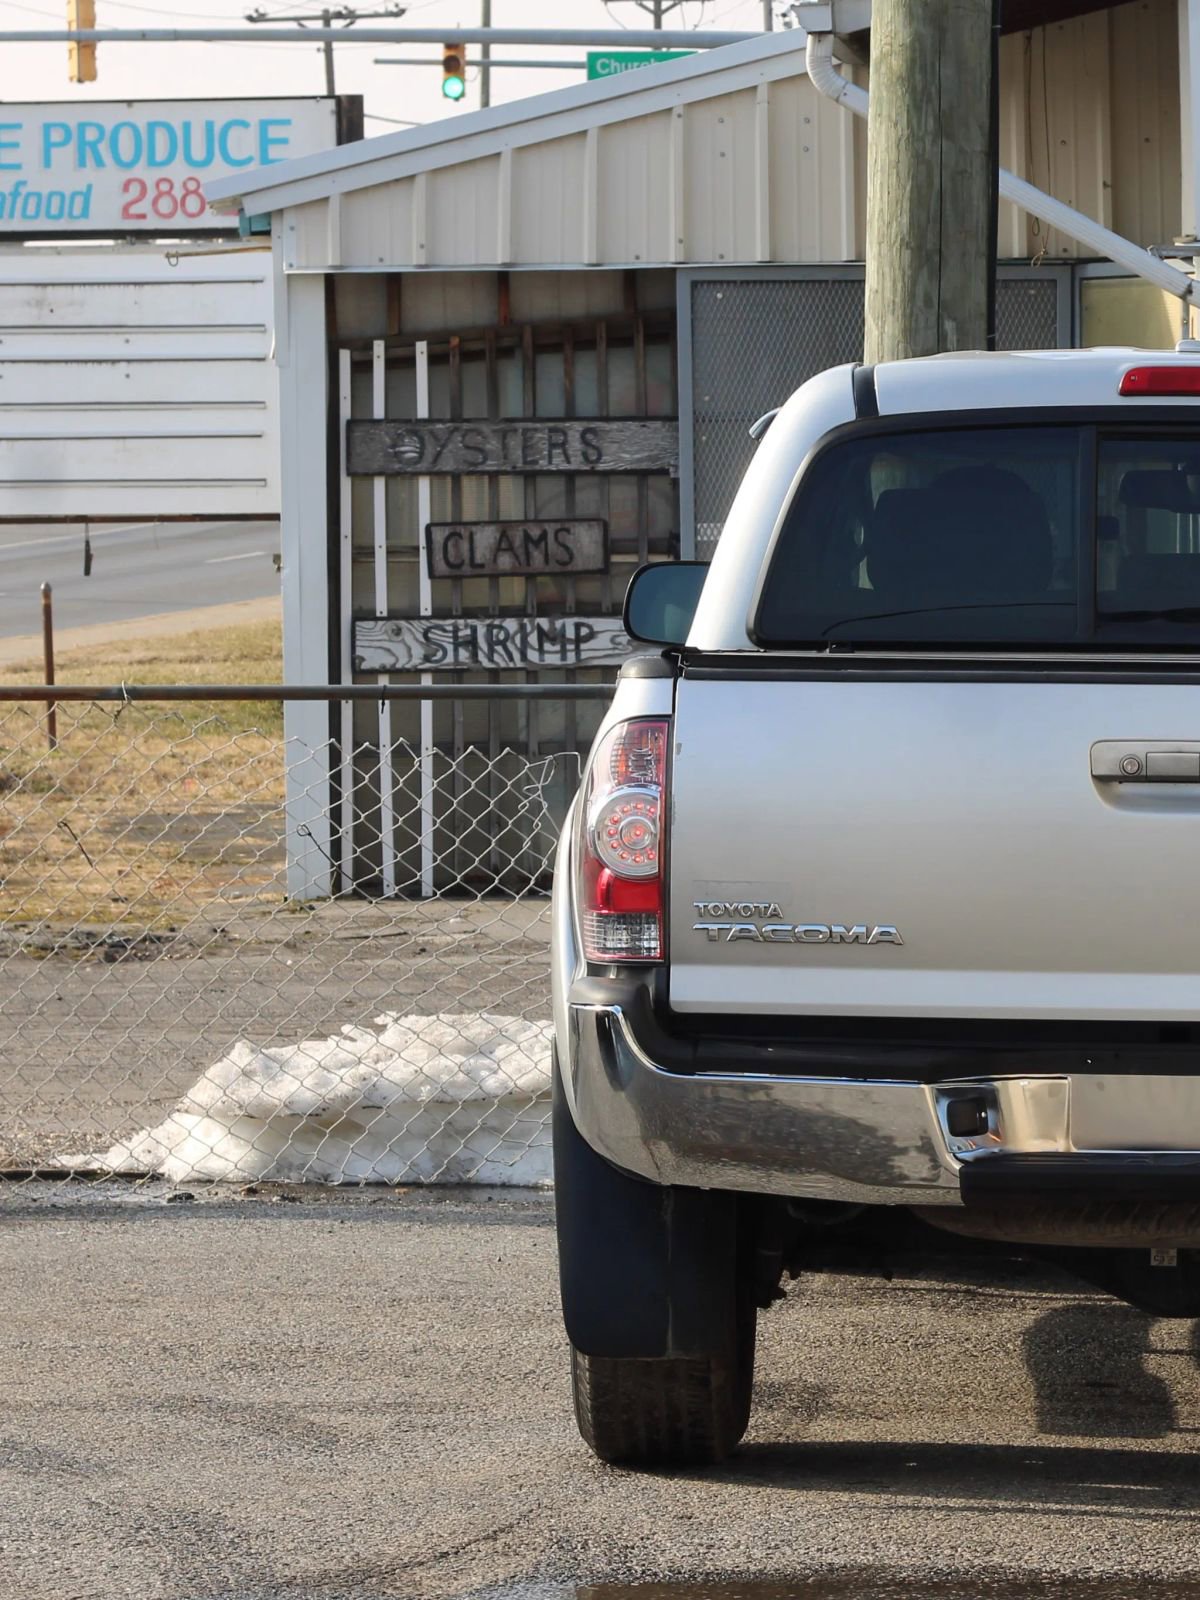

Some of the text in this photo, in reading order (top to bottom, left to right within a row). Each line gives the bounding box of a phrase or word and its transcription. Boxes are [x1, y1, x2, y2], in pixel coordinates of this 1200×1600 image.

[42, 118, 292, 169] PRODUCE
[0, 180, 93, 221] food
[392, 426, 604, 467] OYSTERS
[442, 527, 575, 570] CLAMS
[422, 621, 596, 665] SHRIMP
[693, 901, 784, 919] TOYOTA
[692, 922, 905, 945] TACOMA
